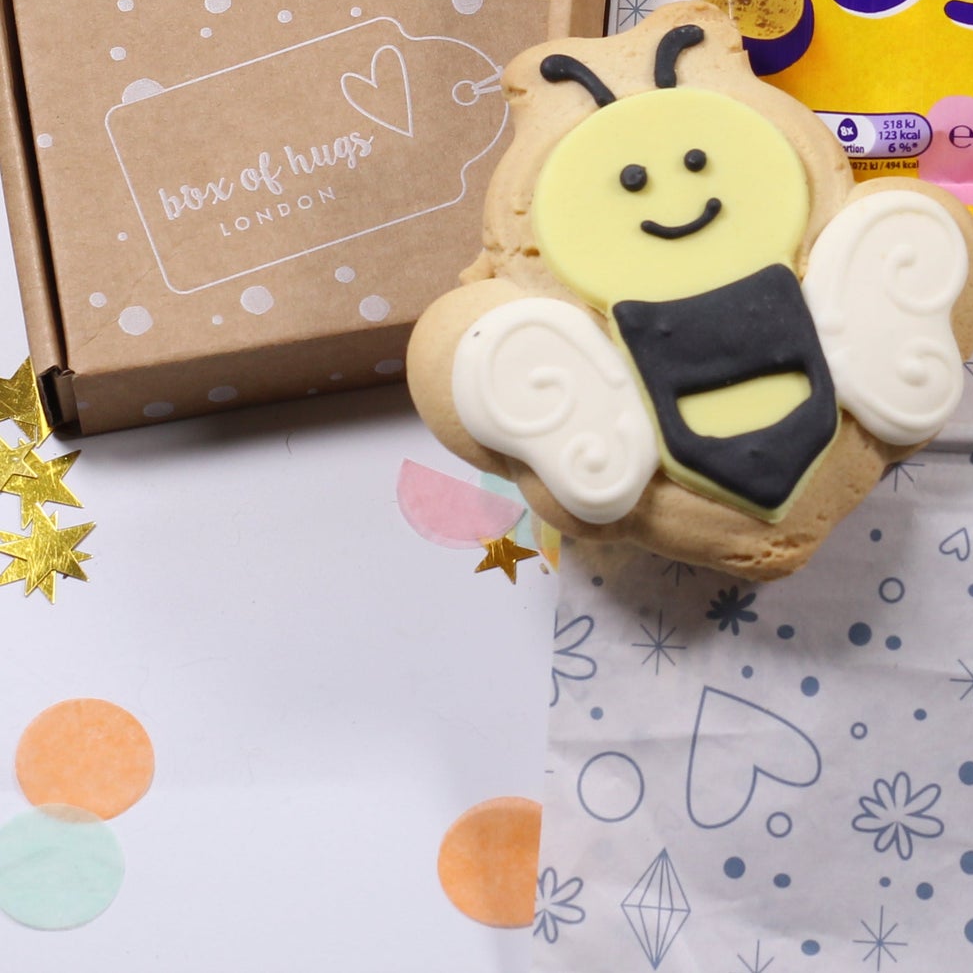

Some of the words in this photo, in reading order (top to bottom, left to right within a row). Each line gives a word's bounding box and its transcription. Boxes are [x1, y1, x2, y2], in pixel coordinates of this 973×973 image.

[883, 120, 903, 129] 518
[904, 119, 916, 129] kJ
[840, 126, 854, 137] 8x
[879, 131, 897, 140] 123
[900, 129, 921, 140] kcal
[888, 143, 896, 153] 6
[850, 161, 868, 171] 072
[886, 160, 900, 169] 494
[902, 160, 919, 169] kcal
[158, 177, 234, 221] box
[240, 151, 283, 195] of
[284, 131, 374, 176] hugs
[219, 186, 336, 237] LONDON
